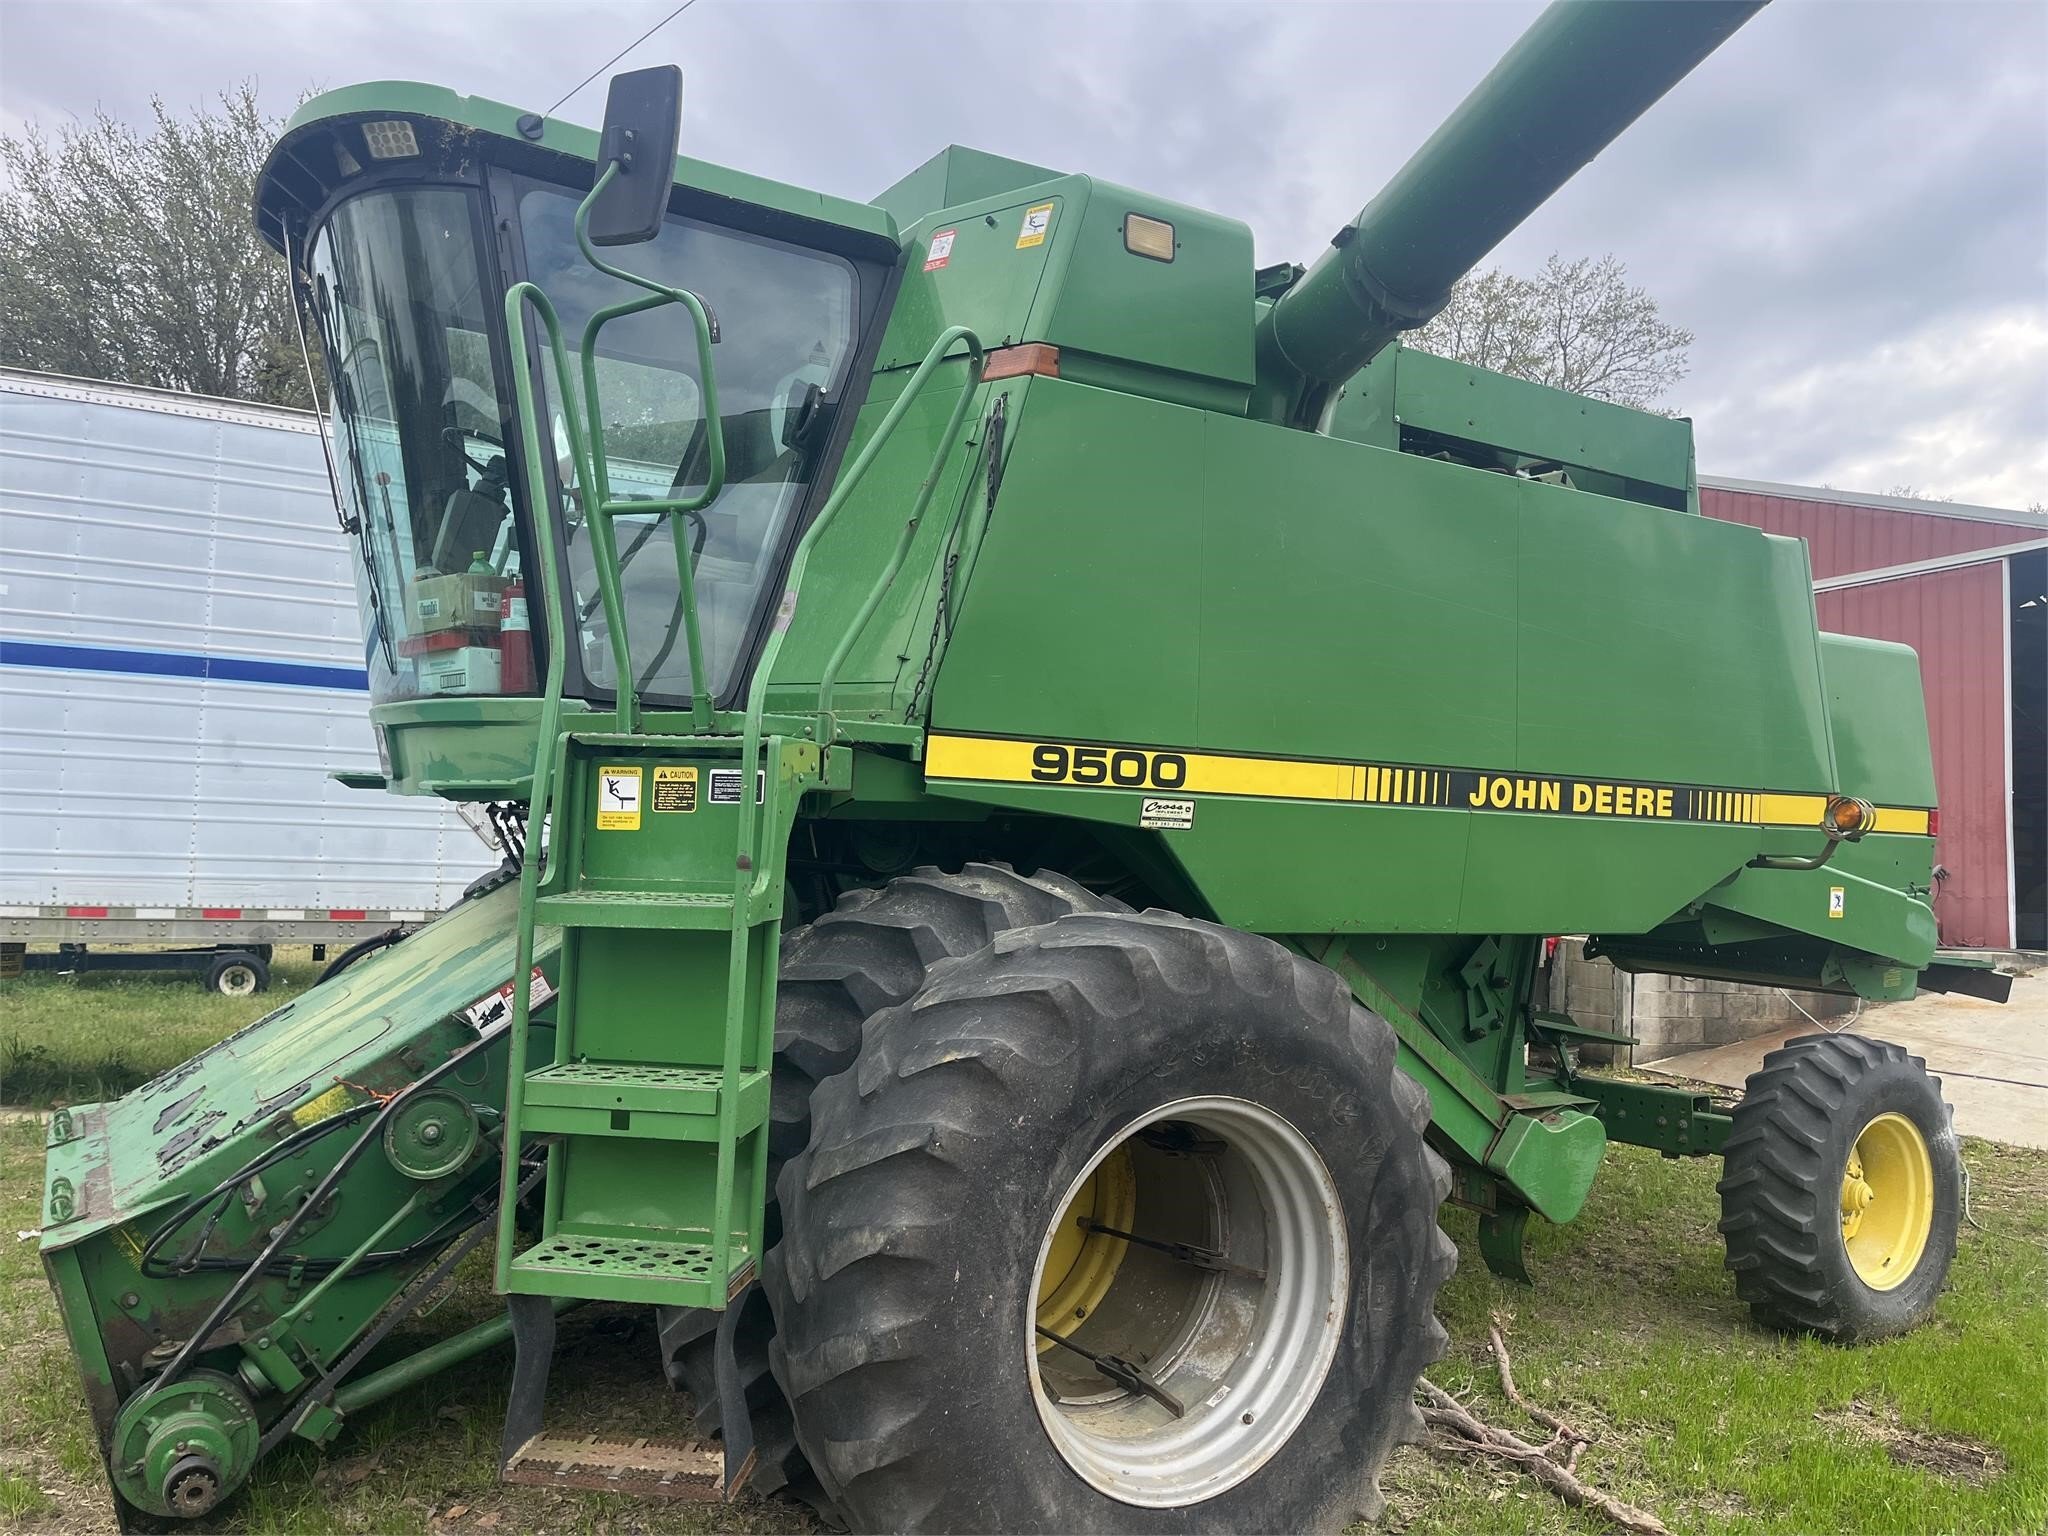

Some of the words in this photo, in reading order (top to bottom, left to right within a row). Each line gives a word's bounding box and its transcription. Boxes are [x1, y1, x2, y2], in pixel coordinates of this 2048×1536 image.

[670, 770, 694, 779] CAUTION
[1031, 746, 1186, 789] 9500
[1144, 801, 1184, 812] Cross
[1469, 776, 1560, 811] JOHN
[1572, 783, 1674, 817] DEERE
